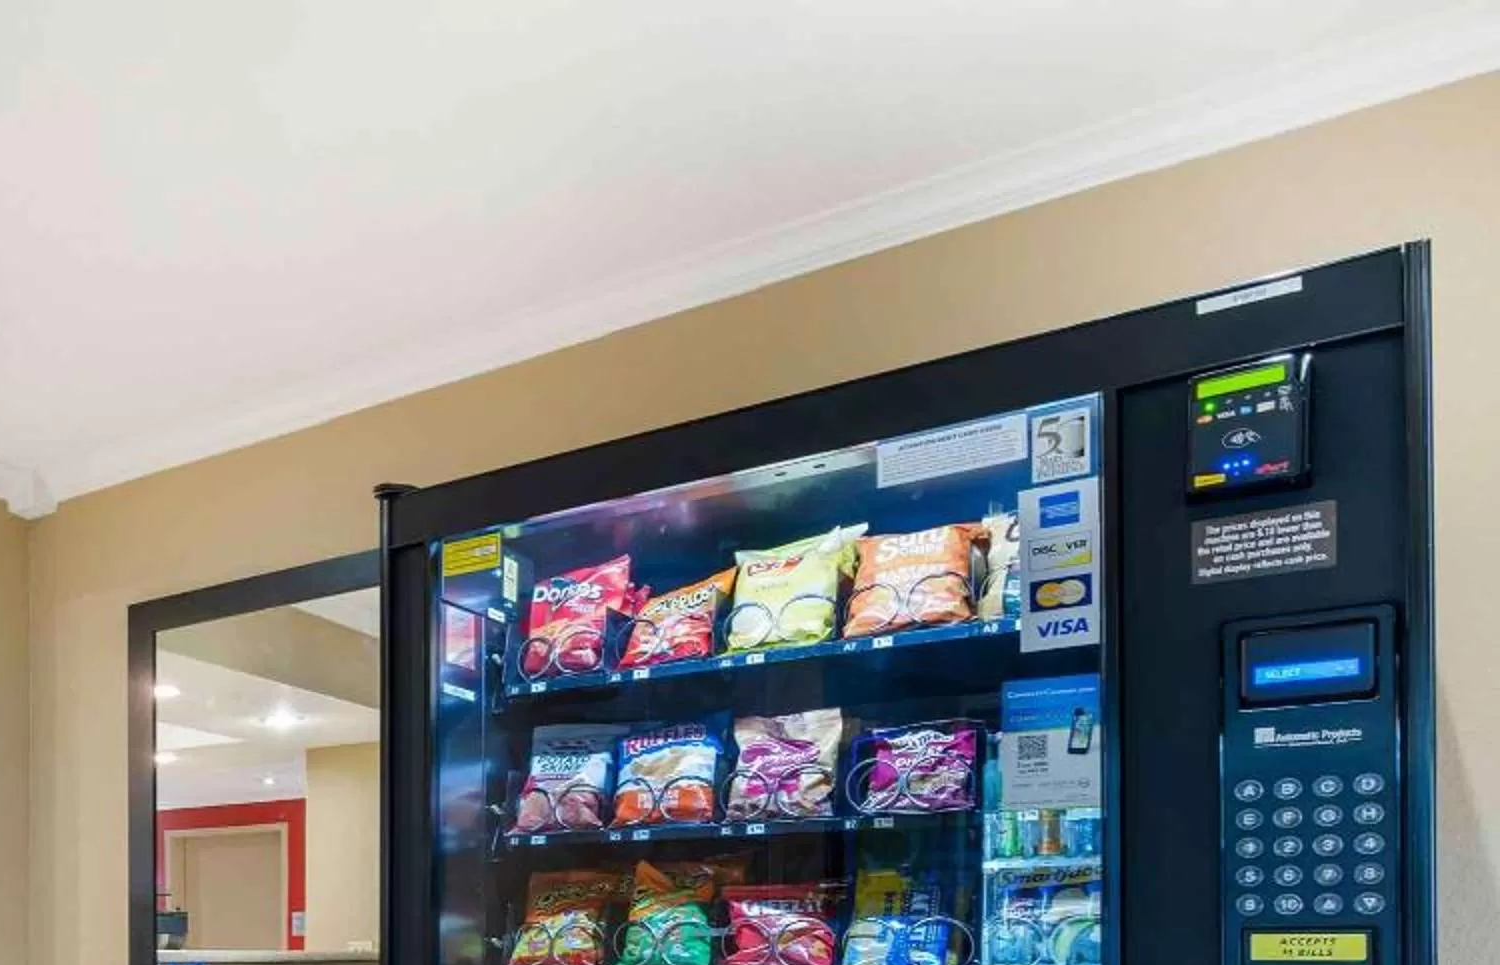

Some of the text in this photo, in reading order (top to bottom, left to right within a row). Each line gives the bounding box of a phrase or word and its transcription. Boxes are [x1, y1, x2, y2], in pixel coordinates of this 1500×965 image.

[1032, 539, 1088, 557] DISCVER
[1037, 618, 1089, 637] VISA
[1279, 937, 1337, 947] ACCEPTS
[1297, 948, 1333, 957] BILLS
